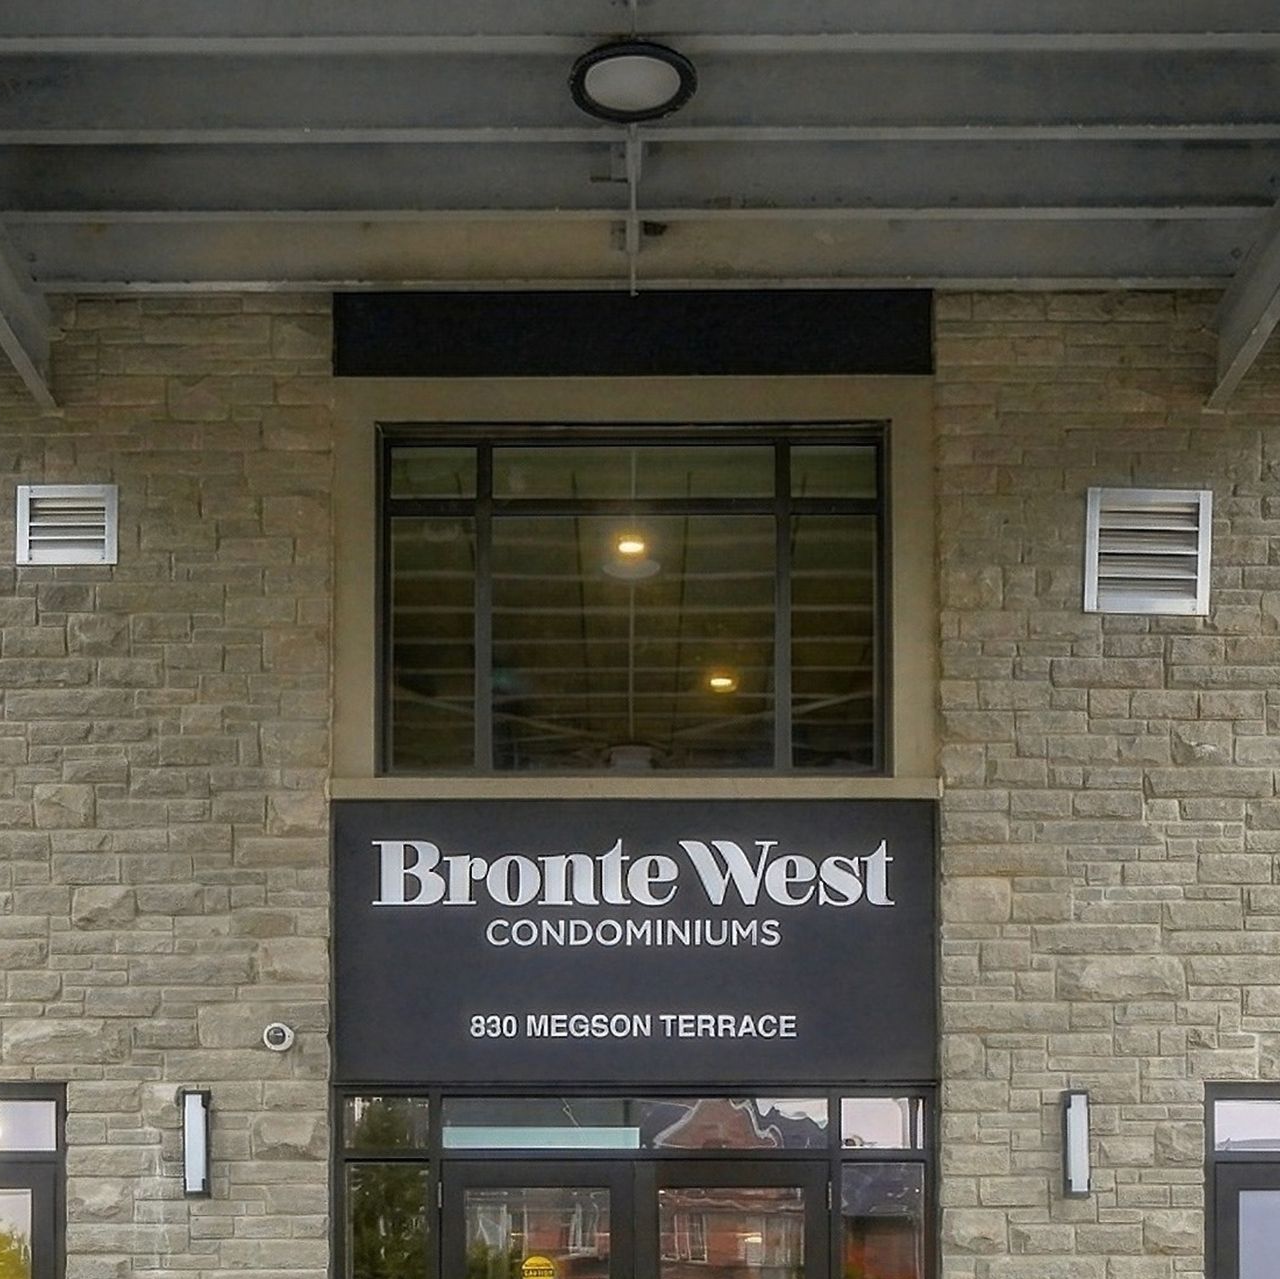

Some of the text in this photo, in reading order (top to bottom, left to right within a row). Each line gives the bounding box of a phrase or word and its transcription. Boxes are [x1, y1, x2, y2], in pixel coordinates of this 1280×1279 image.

[371, 838, 895, 906] Bronte West
[486, 919, 781, 946] CONDOMINIUMS
[470, 1014, 797, 1038] 830 MEGSON TERRACE
